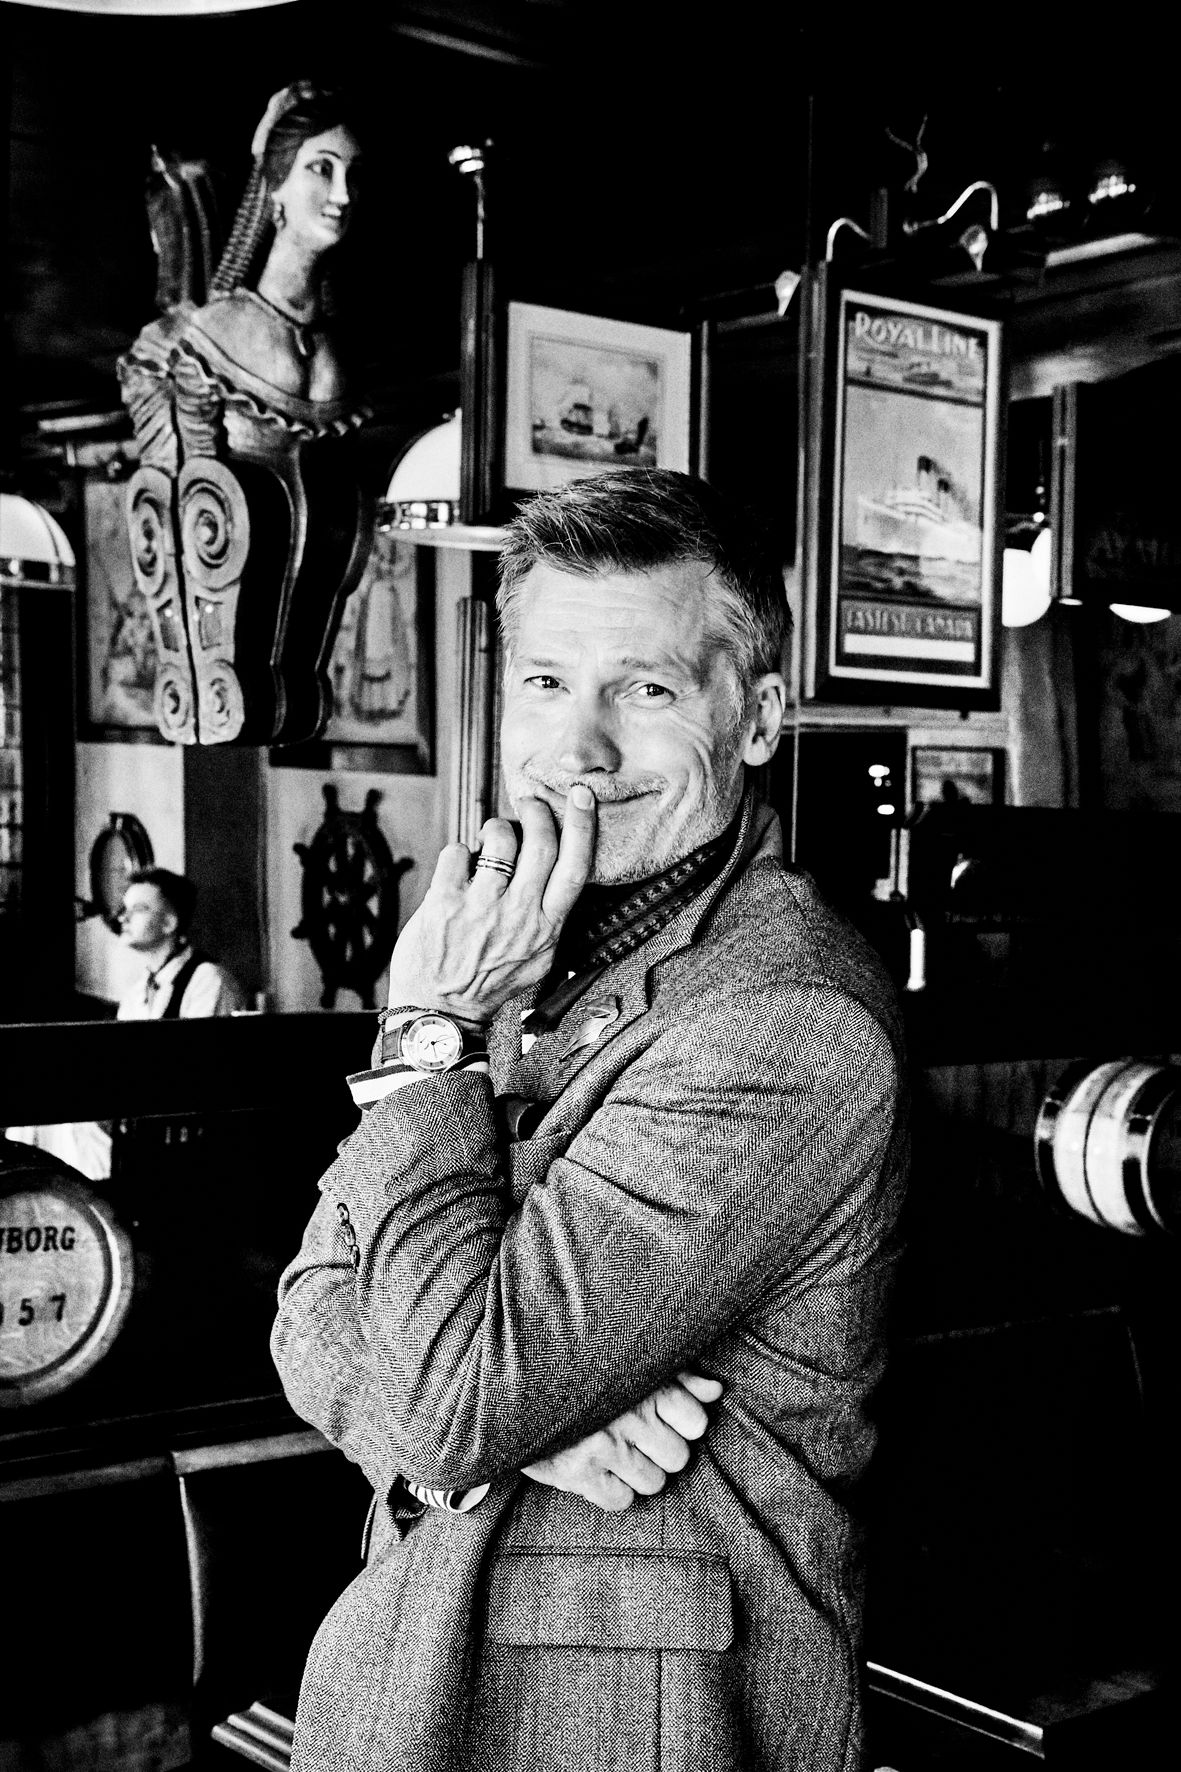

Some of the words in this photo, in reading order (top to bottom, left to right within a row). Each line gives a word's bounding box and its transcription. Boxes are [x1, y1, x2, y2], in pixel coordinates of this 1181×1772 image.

[854, 311, 929, 350] ROYAL
[931, 324, 980, 360] LINE
[0, 1293, 67, 1326] 57
